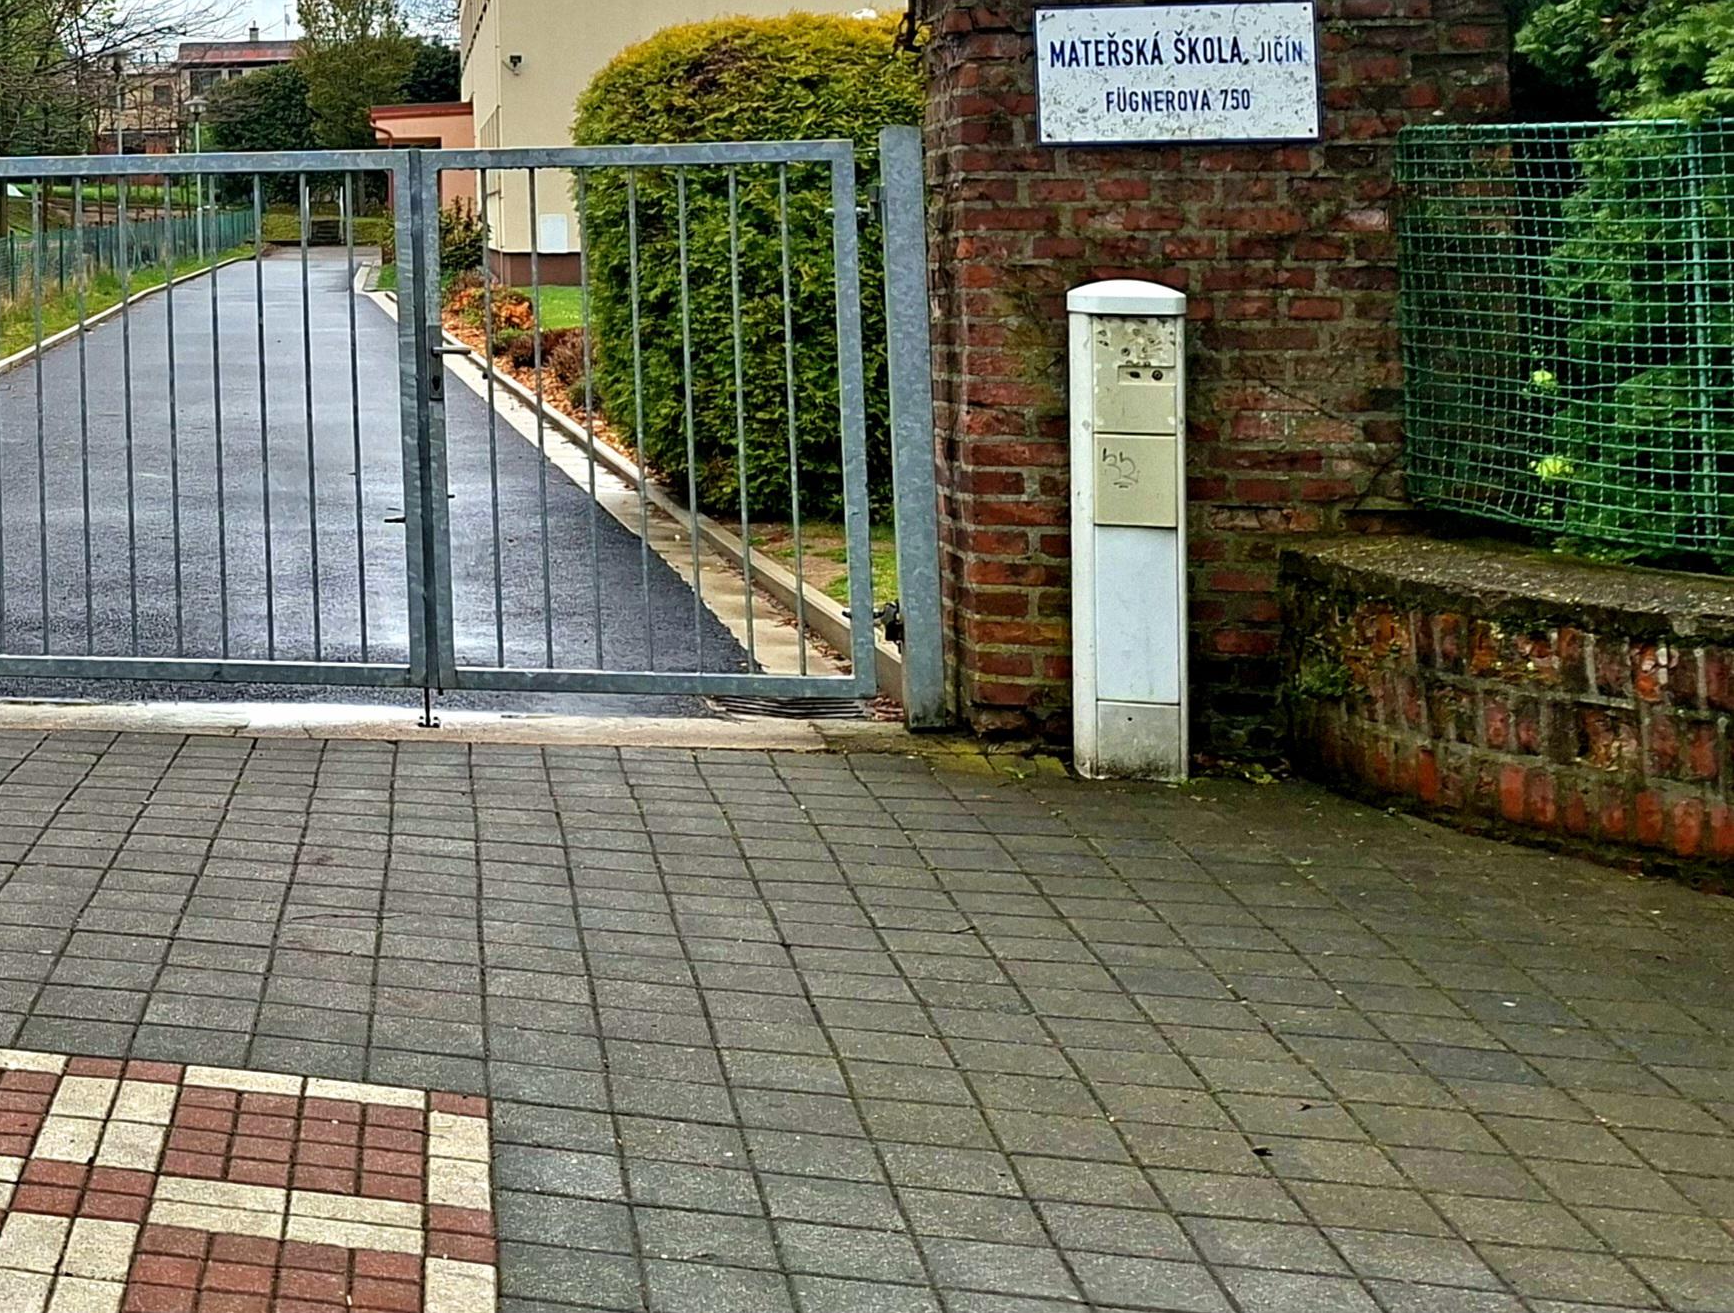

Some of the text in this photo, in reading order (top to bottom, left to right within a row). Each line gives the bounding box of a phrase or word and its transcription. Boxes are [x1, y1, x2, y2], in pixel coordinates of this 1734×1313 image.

[1050, 31, 1163, 68] MATEŘSKÁ
[1257, 34, 1303, 64] JIČÍN
[1105, 86, 1251, 114] FÜGNEROVA 750
